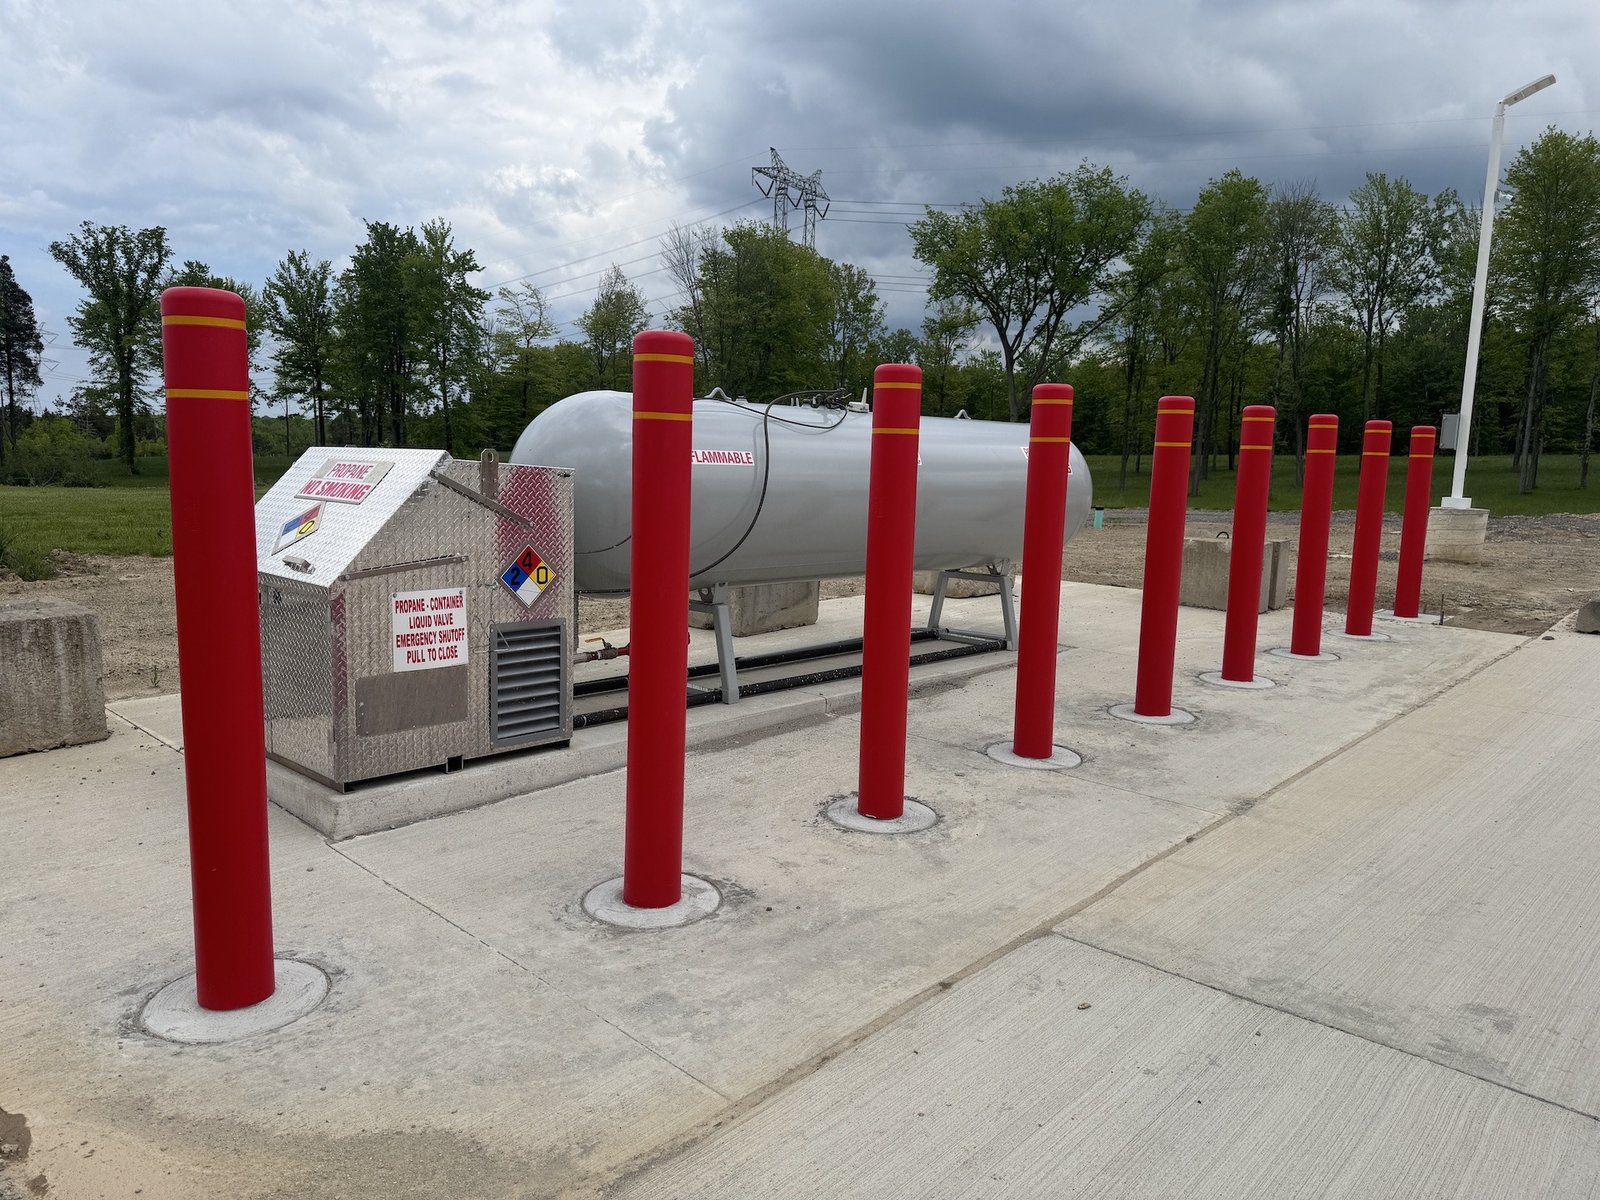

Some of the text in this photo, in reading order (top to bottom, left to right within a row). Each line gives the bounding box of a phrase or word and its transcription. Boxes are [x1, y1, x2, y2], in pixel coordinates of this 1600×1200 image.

[326, 463, 374, 479] PROPANE
[300, 480, 371, 500] NO SMOKING
[522, 552, 533, 570] 4
[511, 566, 548, 585] 2 0
[395, 599, 425, 614] PROPANE
[430, 596, 463, 611] CONTAINER
[409, 613, 453, 629] LIQUID VALVE
[396, 628, 465, 648] EMERGENCY SHUTOFF
[407, 645, 458, 664] PULL TO CLOSE
